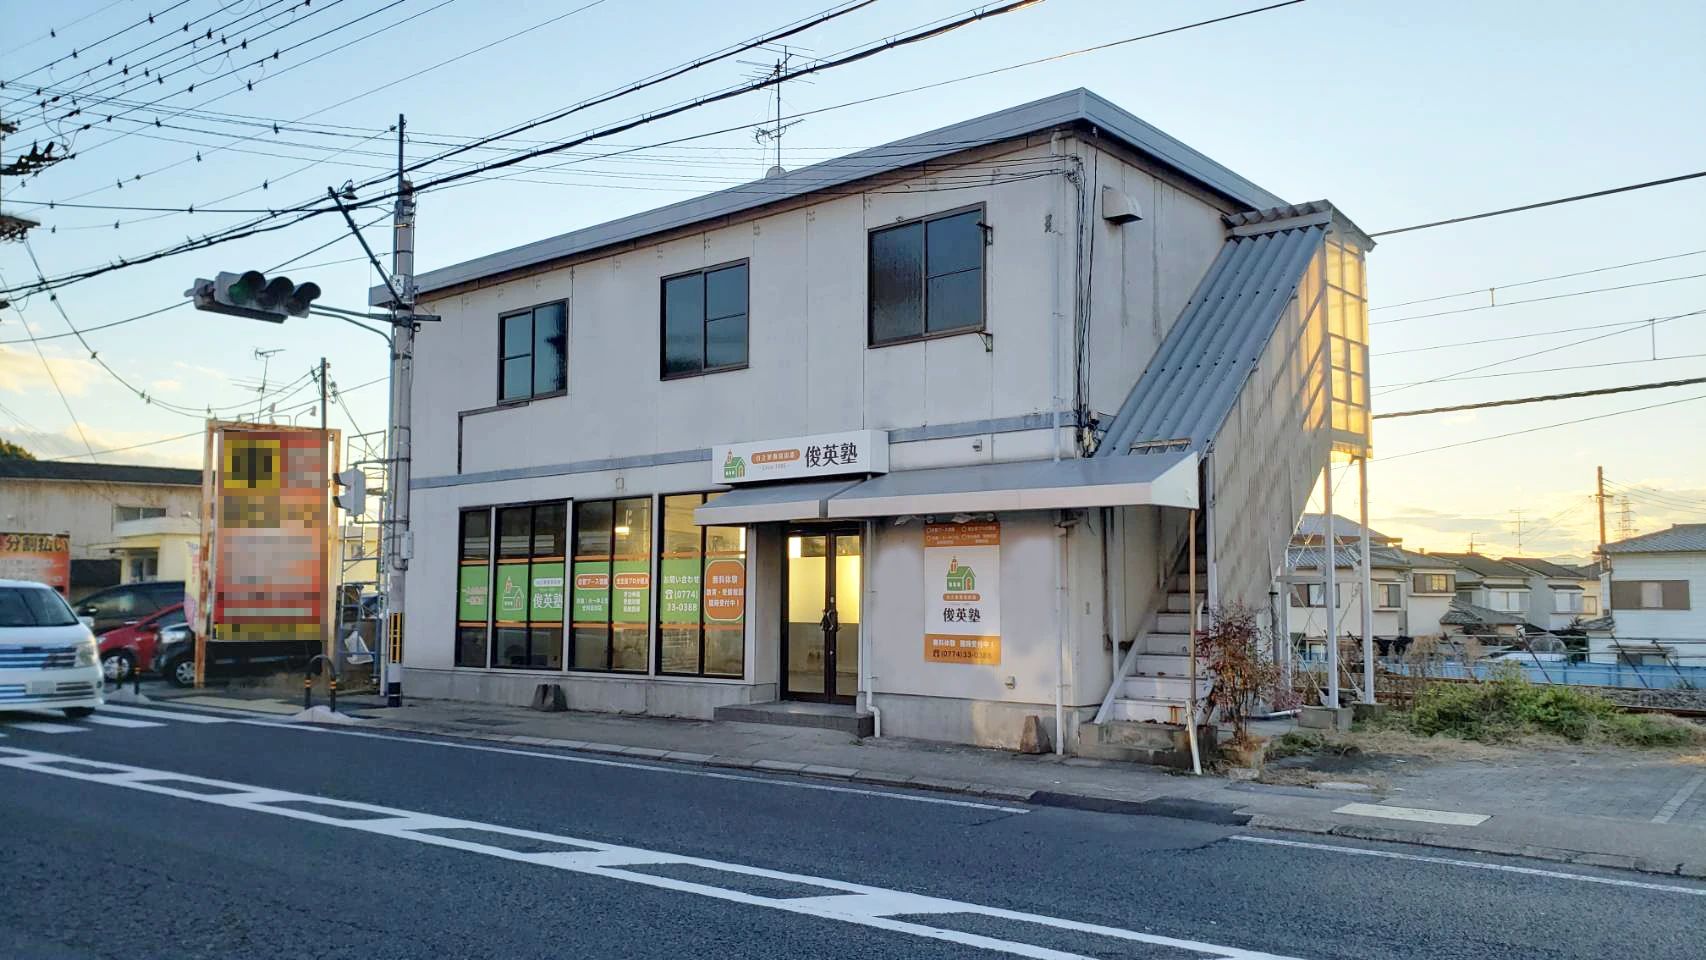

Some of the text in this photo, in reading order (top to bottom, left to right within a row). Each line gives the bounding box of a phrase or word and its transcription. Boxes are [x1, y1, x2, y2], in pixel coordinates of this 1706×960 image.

[805, 442, 858, 468] 俊英塾
[6, 534, 69, 552] 分割払い
[664, 575, 701, 584] お問い合わせ
[533, 592, 563, 609] 俊英塾
[943, 607, 981, 623] 俊英塾
